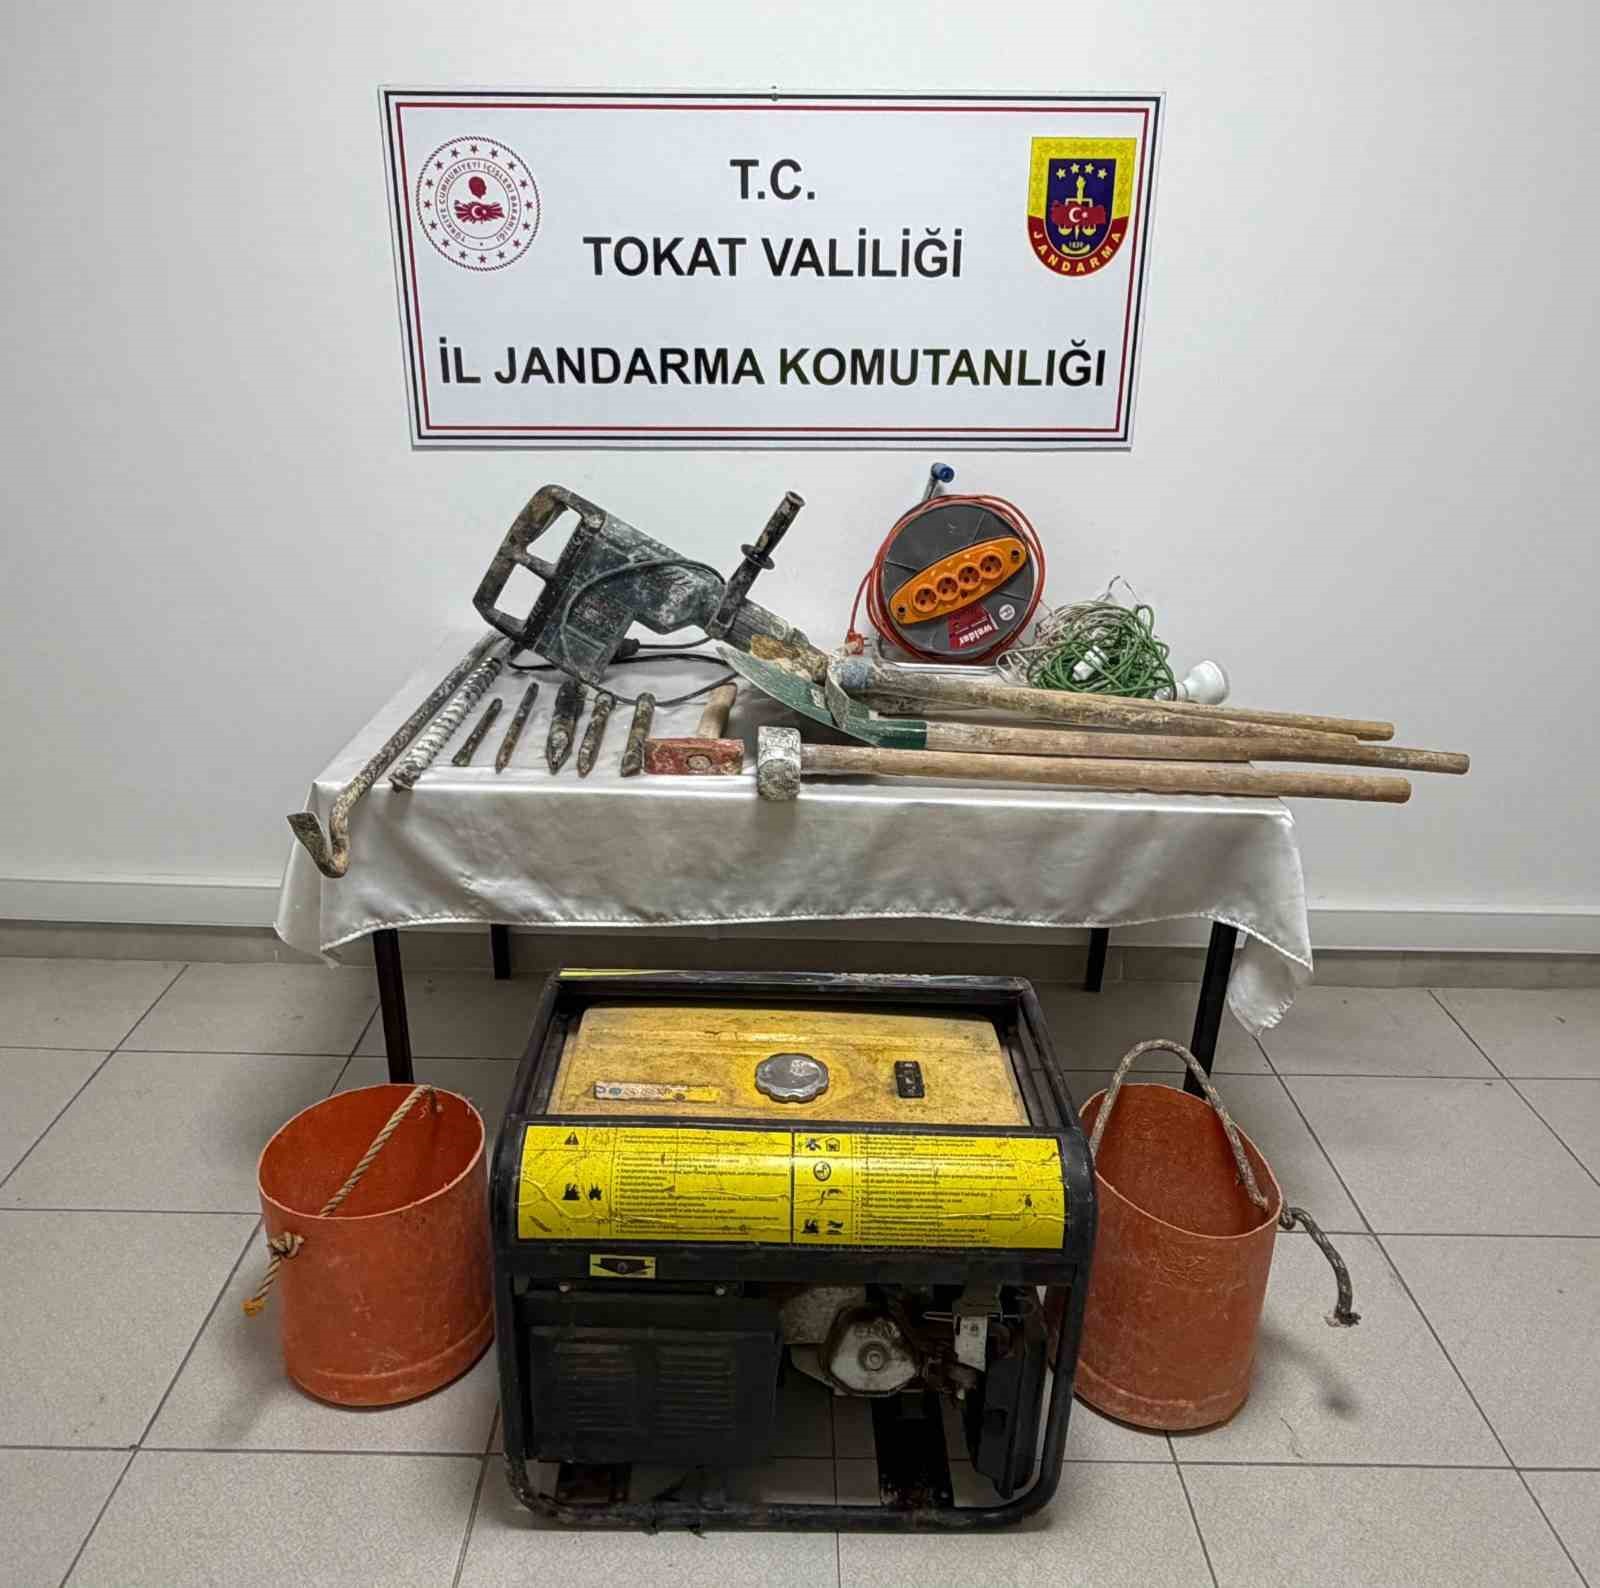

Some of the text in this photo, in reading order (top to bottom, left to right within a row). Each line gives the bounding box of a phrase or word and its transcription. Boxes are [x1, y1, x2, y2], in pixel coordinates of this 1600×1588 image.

[730, 159, 815, 200] T.C.
[583, 227, 963, 278] TOKAT VALİLİĞİ
[1032, 231, 1122, 273] JANDARMA
[439, 337, 1107, 387] İL JANDARMA KOMUTANLIĞI
